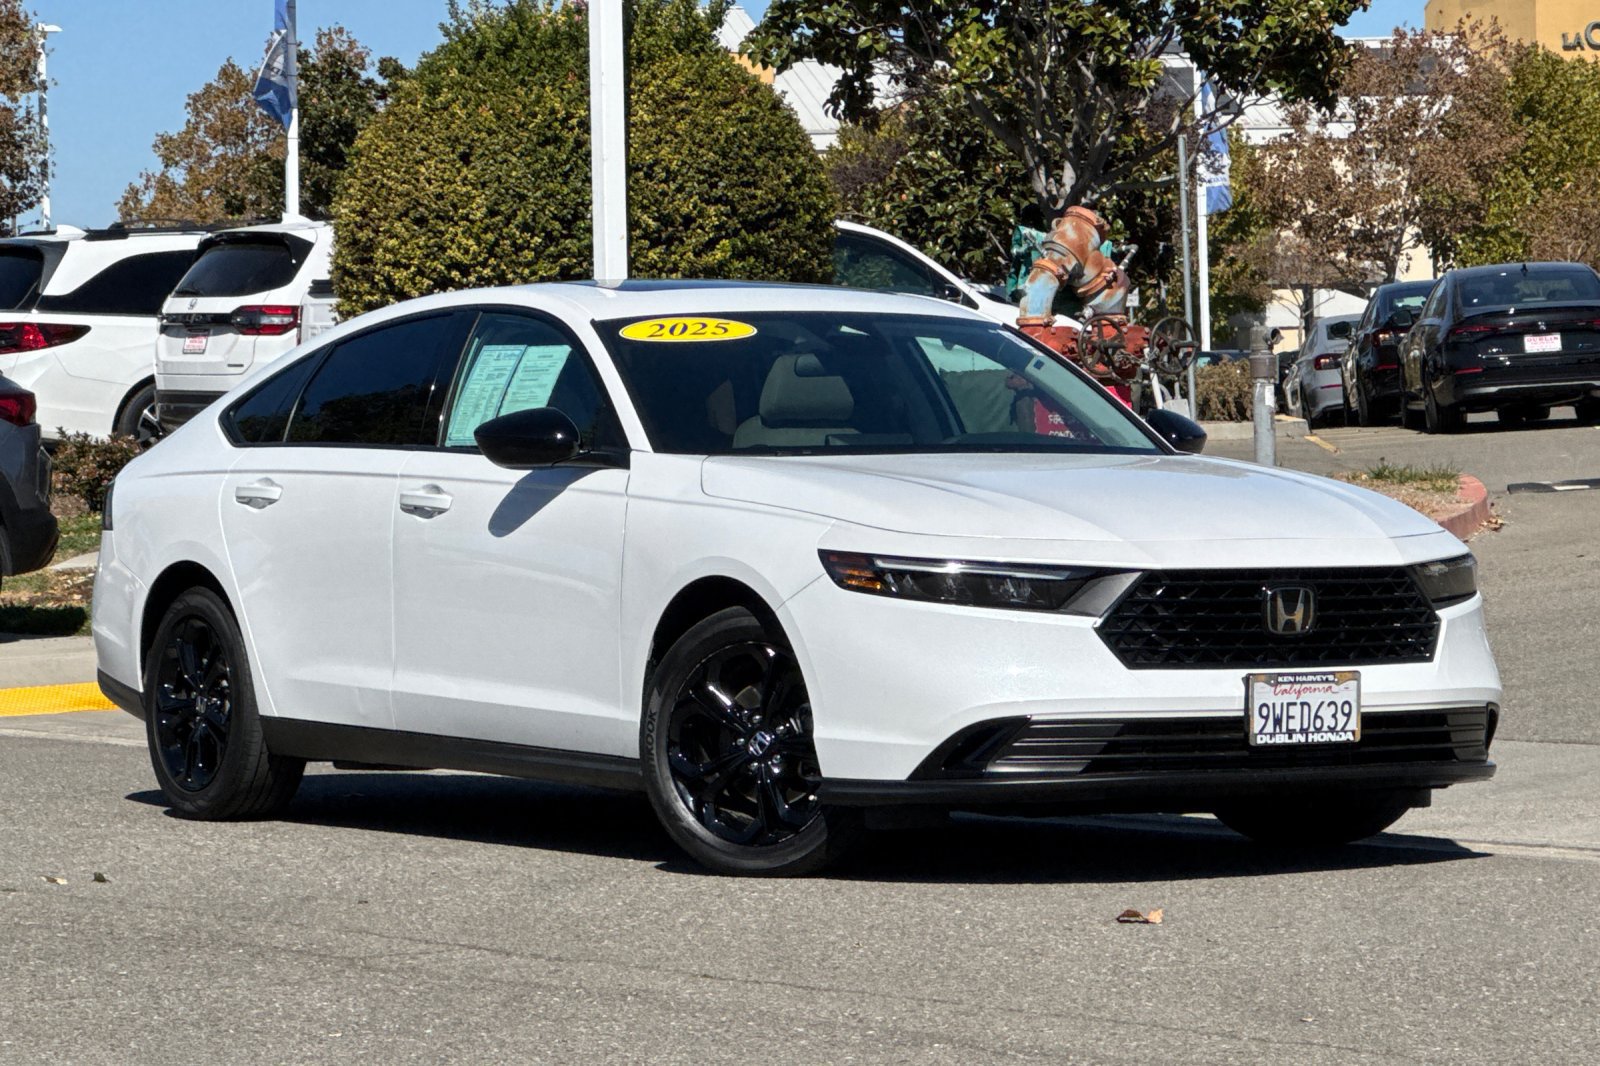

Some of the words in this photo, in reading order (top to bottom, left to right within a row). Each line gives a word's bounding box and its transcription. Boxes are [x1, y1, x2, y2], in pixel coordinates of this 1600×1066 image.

[1561, 32, 1585, 51] LA
[647, 322, 731, 338] 2025
[1277, 675, 1295, 683] KEN
[1295, 674, 1335, 682] HARVEY'S
[1272, 683, 1339, 700] California
[1258, 700, 1353, 734] 9WED639
[1256, 733, 1306, 744] DUBLIN
[1308, 732, 1354, 743] HONDA
